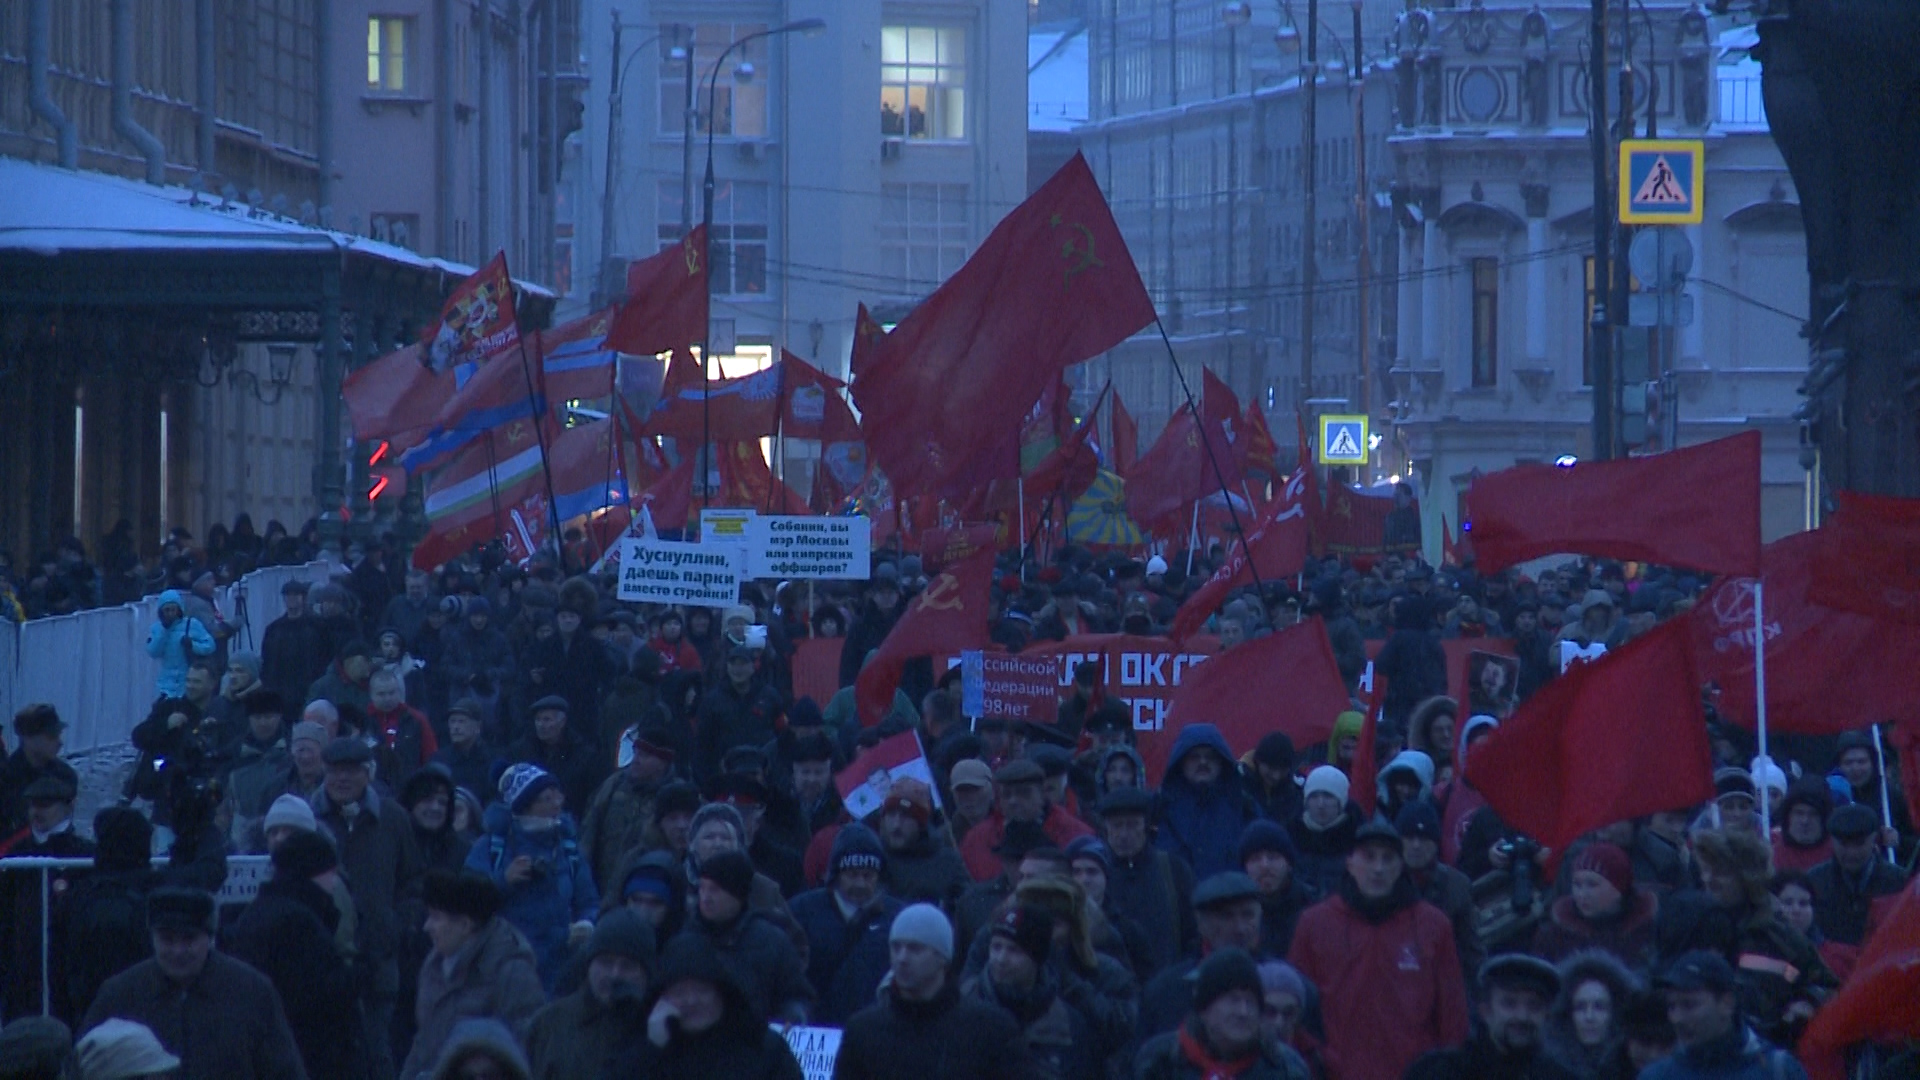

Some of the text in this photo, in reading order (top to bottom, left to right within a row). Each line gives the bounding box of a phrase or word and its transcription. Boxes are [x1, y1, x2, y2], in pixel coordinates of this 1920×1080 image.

[770, 520, 849, 533] Собянин, вы
[770, 535, 849, 547] мэр Москвы
[632, 545, 730, 568] Хуснуллин,
[765, 550, 853, 561] или кипрских
[770, 561, 848, 575] оффшоров?
[624, 567, 735, 587] даешь парки
[623, 583, 734, 601] вместо стройки!
